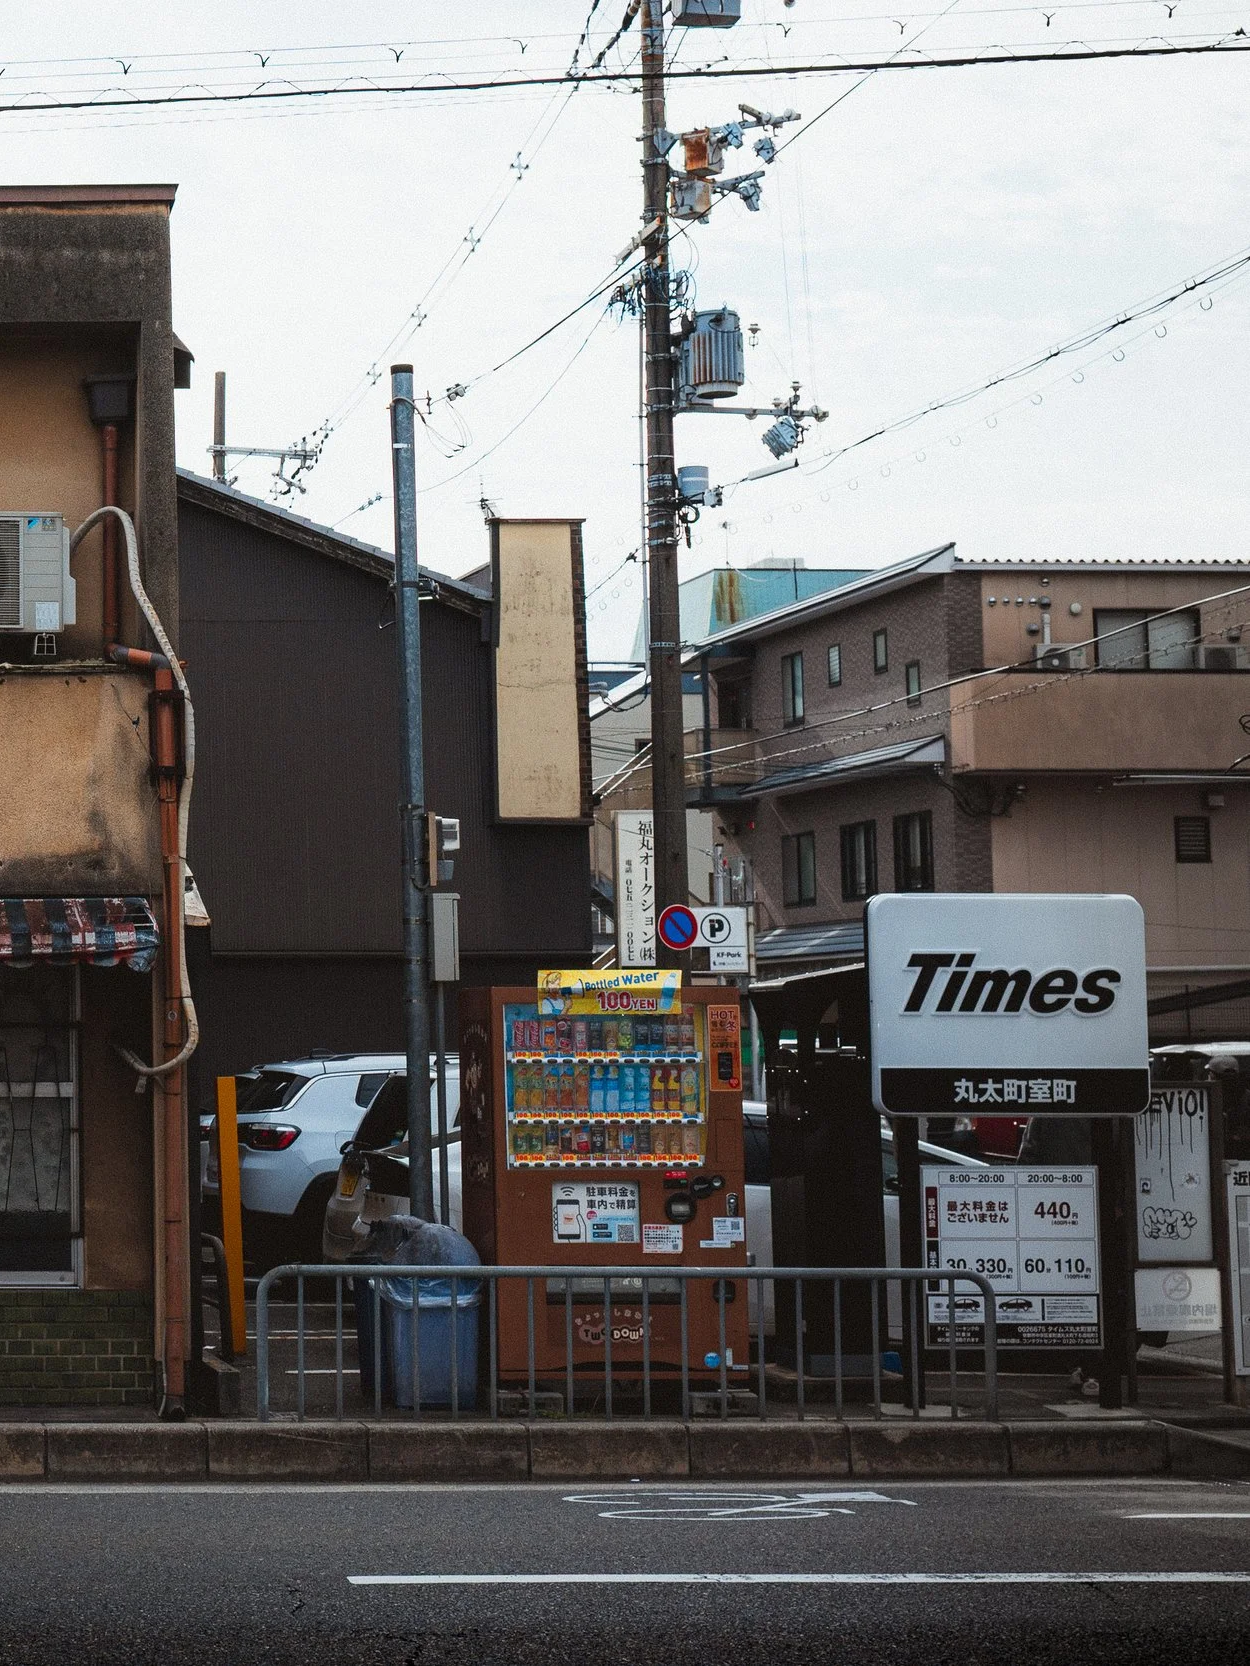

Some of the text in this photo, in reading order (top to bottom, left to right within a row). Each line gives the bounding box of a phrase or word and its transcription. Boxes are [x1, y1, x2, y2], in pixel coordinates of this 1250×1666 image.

[638, 820, 656, 962] 福丸オークション(株
[584, 970, 660, 992] Bottled Water
[902, 953, 1122, 1014] Times
[710, 1010, 735, 1020] HOT
[953, 1078, 1077, 1104] 丸太町室町
[586, 1186, 636, 1198] 駐車料金を
[586, 1199, 637, 1210] 車内で精算
[947, 1200, 1009, 1212] 最大料金は
[947, 1212, 1010, 1224] ございません
